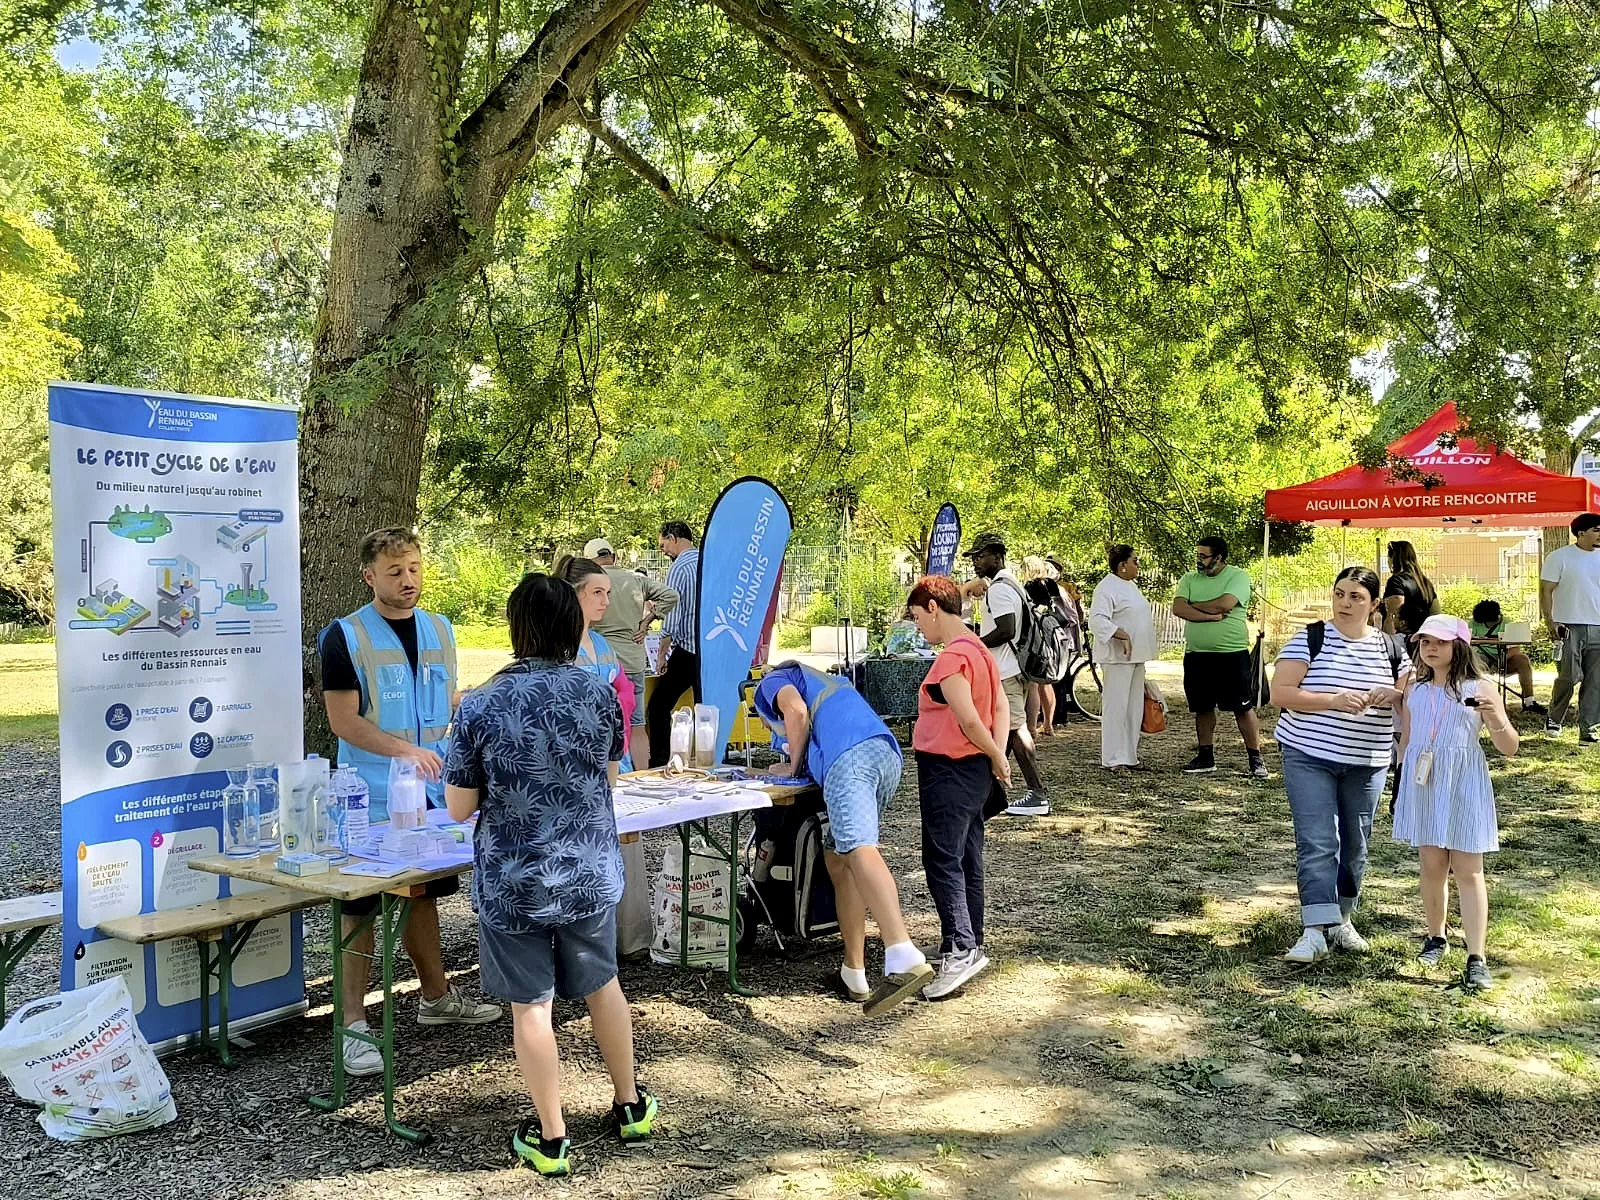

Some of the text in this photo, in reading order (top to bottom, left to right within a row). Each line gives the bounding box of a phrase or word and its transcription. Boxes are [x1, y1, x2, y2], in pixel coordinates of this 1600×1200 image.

[158, 408, 217, 422] EAU DU BASSIN
[158, 416, 193, 427] RENNAIS
[76, 448, 276, 475] LE PETIT CYCLE DE L'EAU
[1405, 456, 1491, 466] GUILLON
[96, 481, 263, 498] Du milieu naturel jusqu'au robinet
[1306, 491, 1537, 512] AIGUILLON À VOTRE RENCONTRE
[727, 496, 775, 620] EAU DU BASSIN
[738, 555, 769, 628] RENNAIS
[102, 645, 262, 662] Les différentes ressources en eau
[141, 658, 228, 671] du Bassin Rennais
[141, 707, 159, 716] PRISE
[160, 706, 179, 715] D'EAU
[221, 702, 253, 711] BARRAGES
[226, 733, 254, 744] CAPTAGES
[141, 744, 164, 753] PRISES
[165, 742, 183, 751] D'EAU
[122, 800, 140, 811] Les
[142, 793, 197, 807] différentes
[115, 808, 171, 824] traitement
[172, 805, 185, 815] de
[186, 802, 210, 813] l'eau
[153, 836, 160, 845] 2
[102, 869, 120, 879] L'EAU
[695, 873, 702, 881] AU
[665, 881, 682, 891] MAI
[77, 948, 82, 956] 4
[91, 957, 128, 970] FILTRATION
[86, 971, 100, 980] SUR
[101, 962, 133, 976] CHARBON
[25, 1057, 40, 1069] ÇA
[96, 1020, 111, 1035] AU
[51, 1047, 91, 1072] MAIS
[91, 1023, 125, 1053] NON
